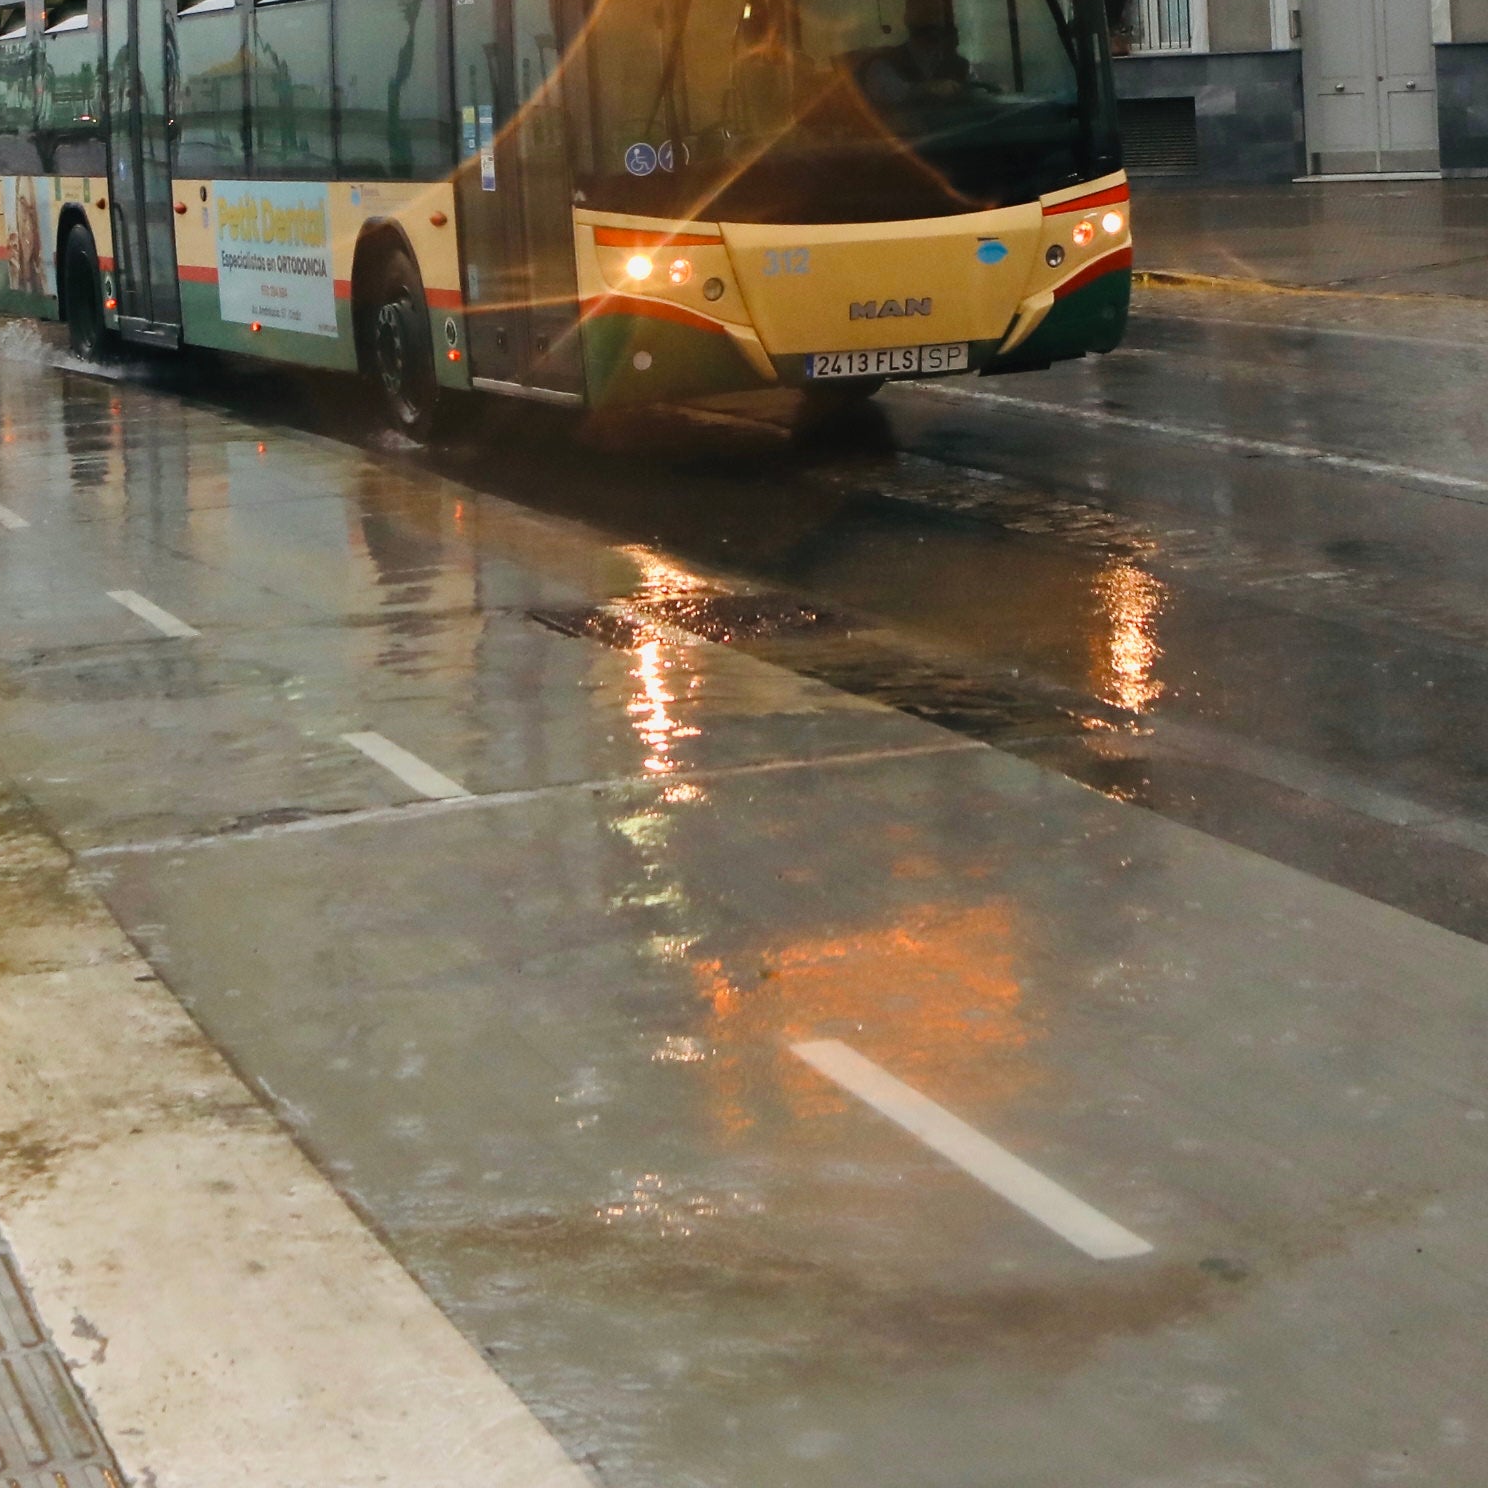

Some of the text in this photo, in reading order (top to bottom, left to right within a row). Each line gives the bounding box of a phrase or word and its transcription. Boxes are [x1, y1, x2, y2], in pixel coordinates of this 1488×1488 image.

[217, 195, 258, 243] Petit
[262, 199, 327, 248] Dental
[221, 250, 328, 278] Especialistas en ORTODONCIA
[764, 248, 810, 276] 312
[849, 298, 932, 320] MAN
[817, 346, 962, 376] 2413 FLS SP
